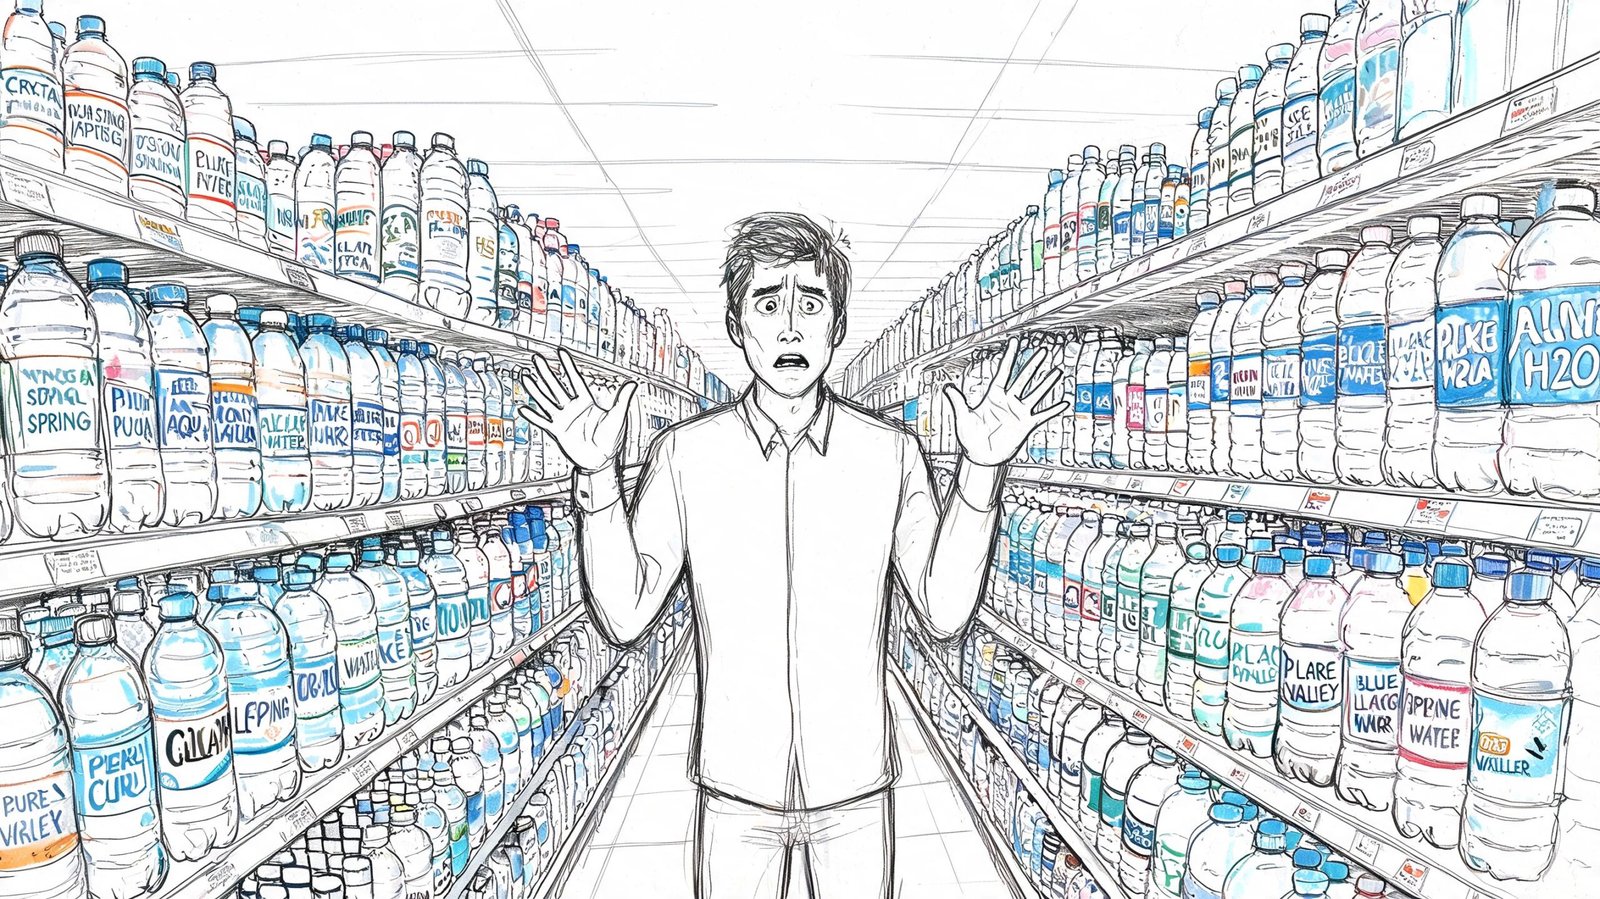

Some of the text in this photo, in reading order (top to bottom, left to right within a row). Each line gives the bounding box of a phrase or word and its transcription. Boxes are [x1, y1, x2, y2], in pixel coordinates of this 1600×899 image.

[1523, 343, 1600, 391] H2O
[28, 412, 91, 434] SPRING
[1356, 674, 1398, 691] BLUE
